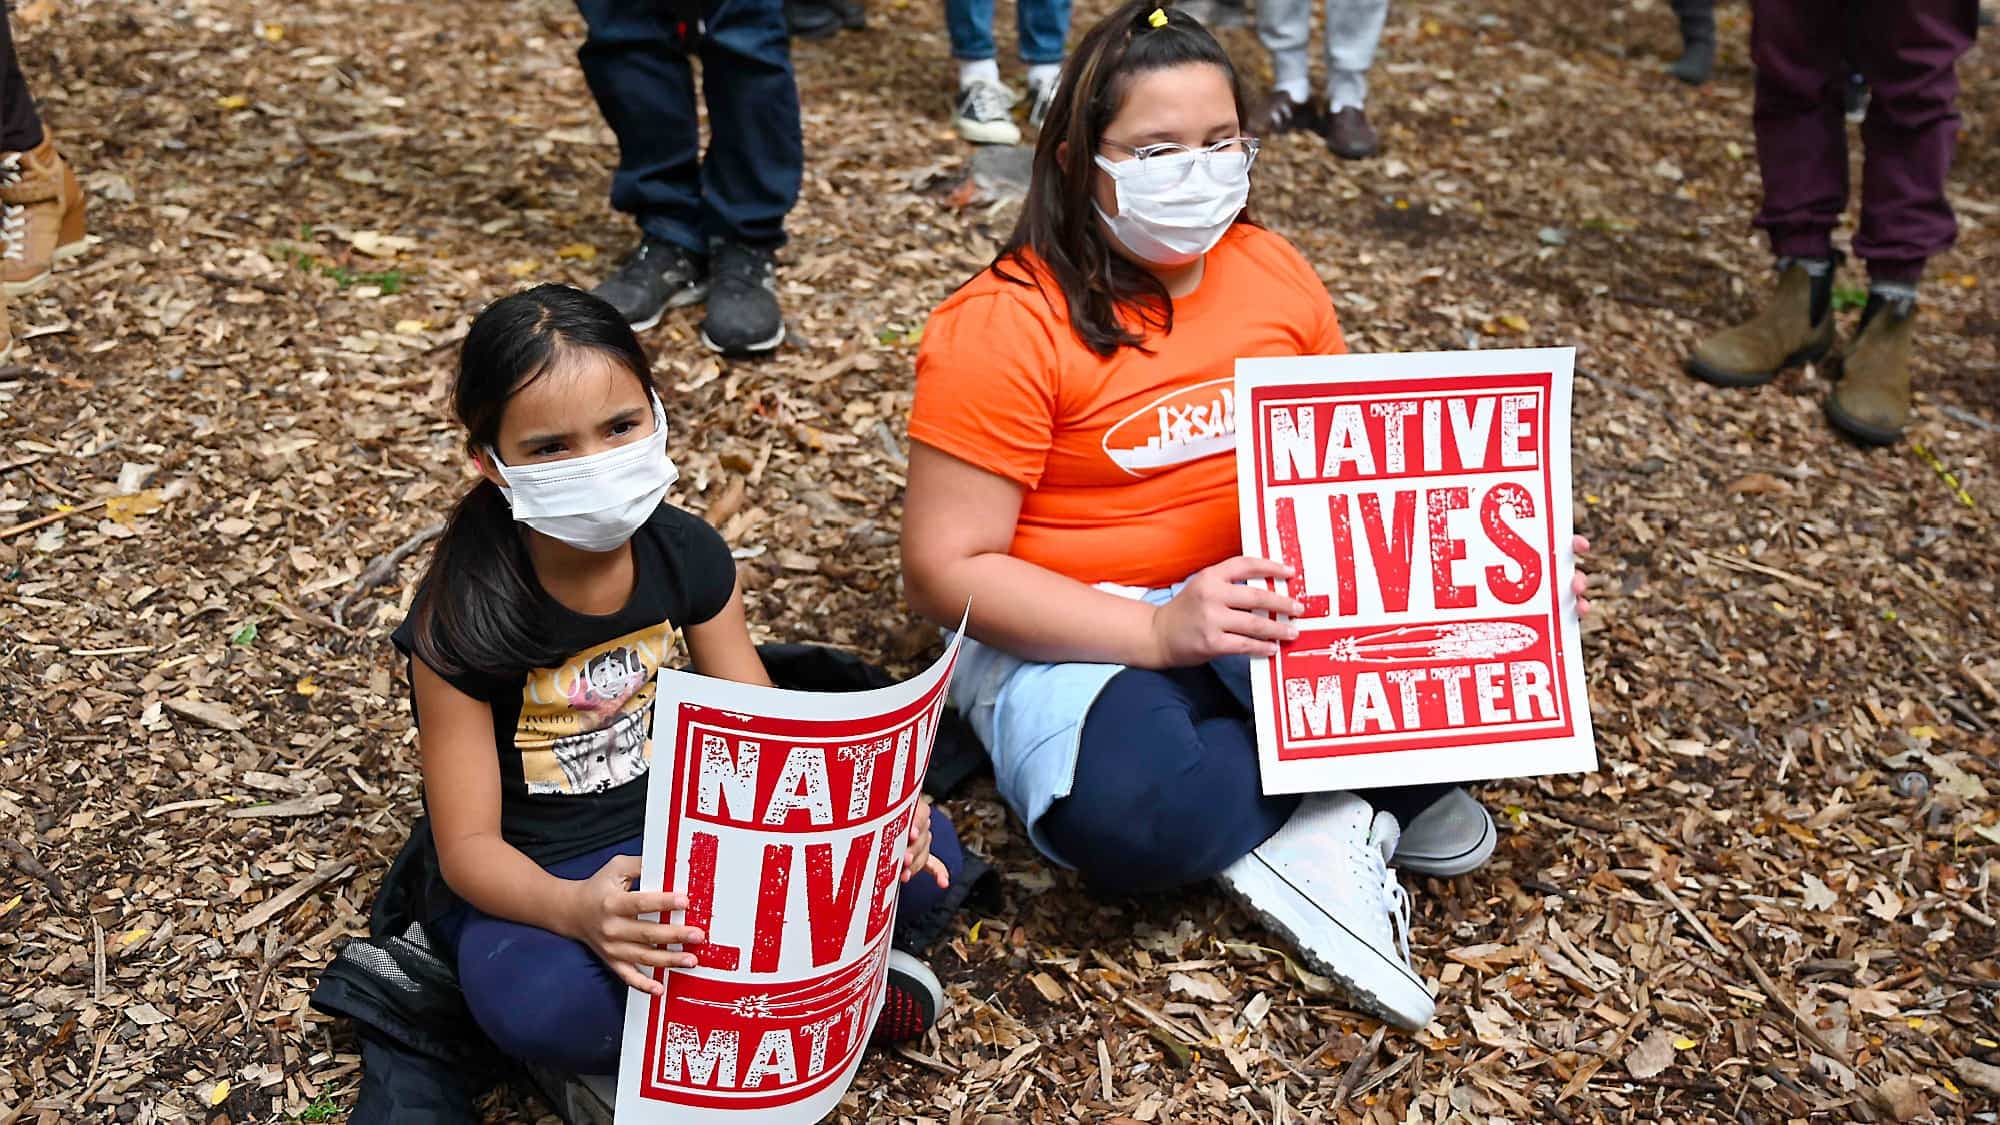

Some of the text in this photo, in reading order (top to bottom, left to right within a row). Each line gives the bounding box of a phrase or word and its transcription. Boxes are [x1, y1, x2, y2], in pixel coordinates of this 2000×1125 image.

[1269, 395, 1539, 480] NATIVE
[1275, 482, 1542, 618] LIVES
[1285, 660, 1557, 738] MATTER
[696, 698, 942, 826] NATIV
[684, 804, 911, 973] LIVE
[663, 985, 872, 1088] MATT
